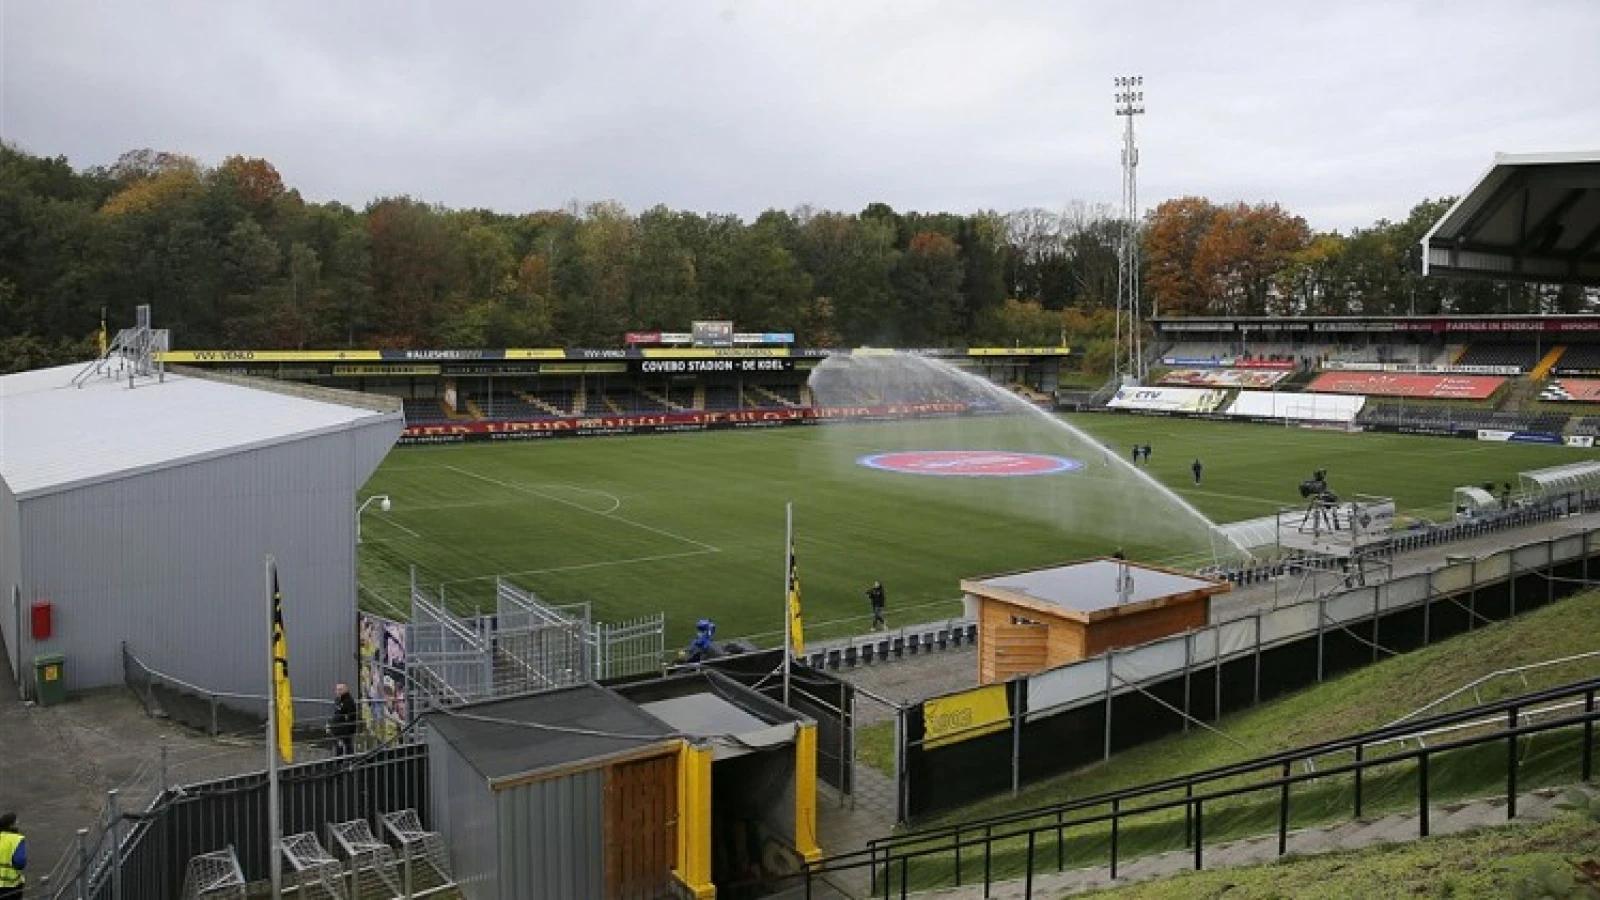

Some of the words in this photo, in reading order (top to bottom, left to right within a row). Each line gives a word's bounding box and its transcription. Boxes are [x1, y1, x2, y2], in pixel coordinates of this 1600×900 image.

[193, 351, 254, 360] VVV-VENLO
[642, 361, 685, 373] COVEBO
[687, 361, 733, 371] STADION
[742, 361, 756, 371] DE
[757, 360, 784, 371] KOEL
